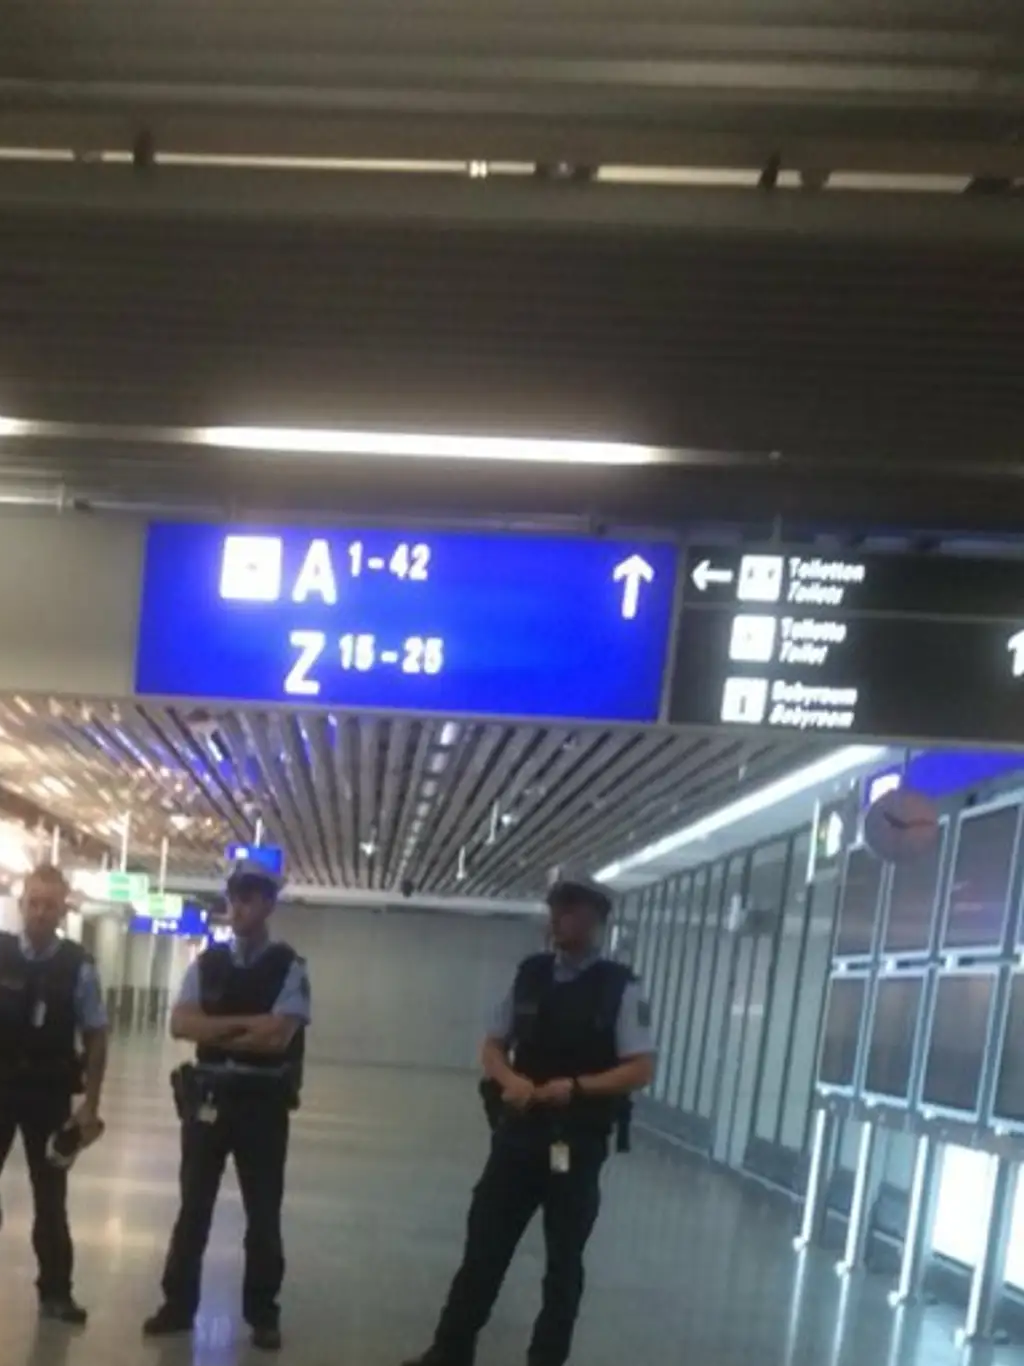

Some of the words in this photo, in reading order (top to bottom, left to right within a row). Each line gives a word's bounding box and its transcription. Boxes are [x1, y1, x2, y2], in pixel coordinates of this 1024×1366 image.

[292, 539, 337, 605] A
[348, 541, 432, 581] 1-42
[284, 631, 326, 696] Z
